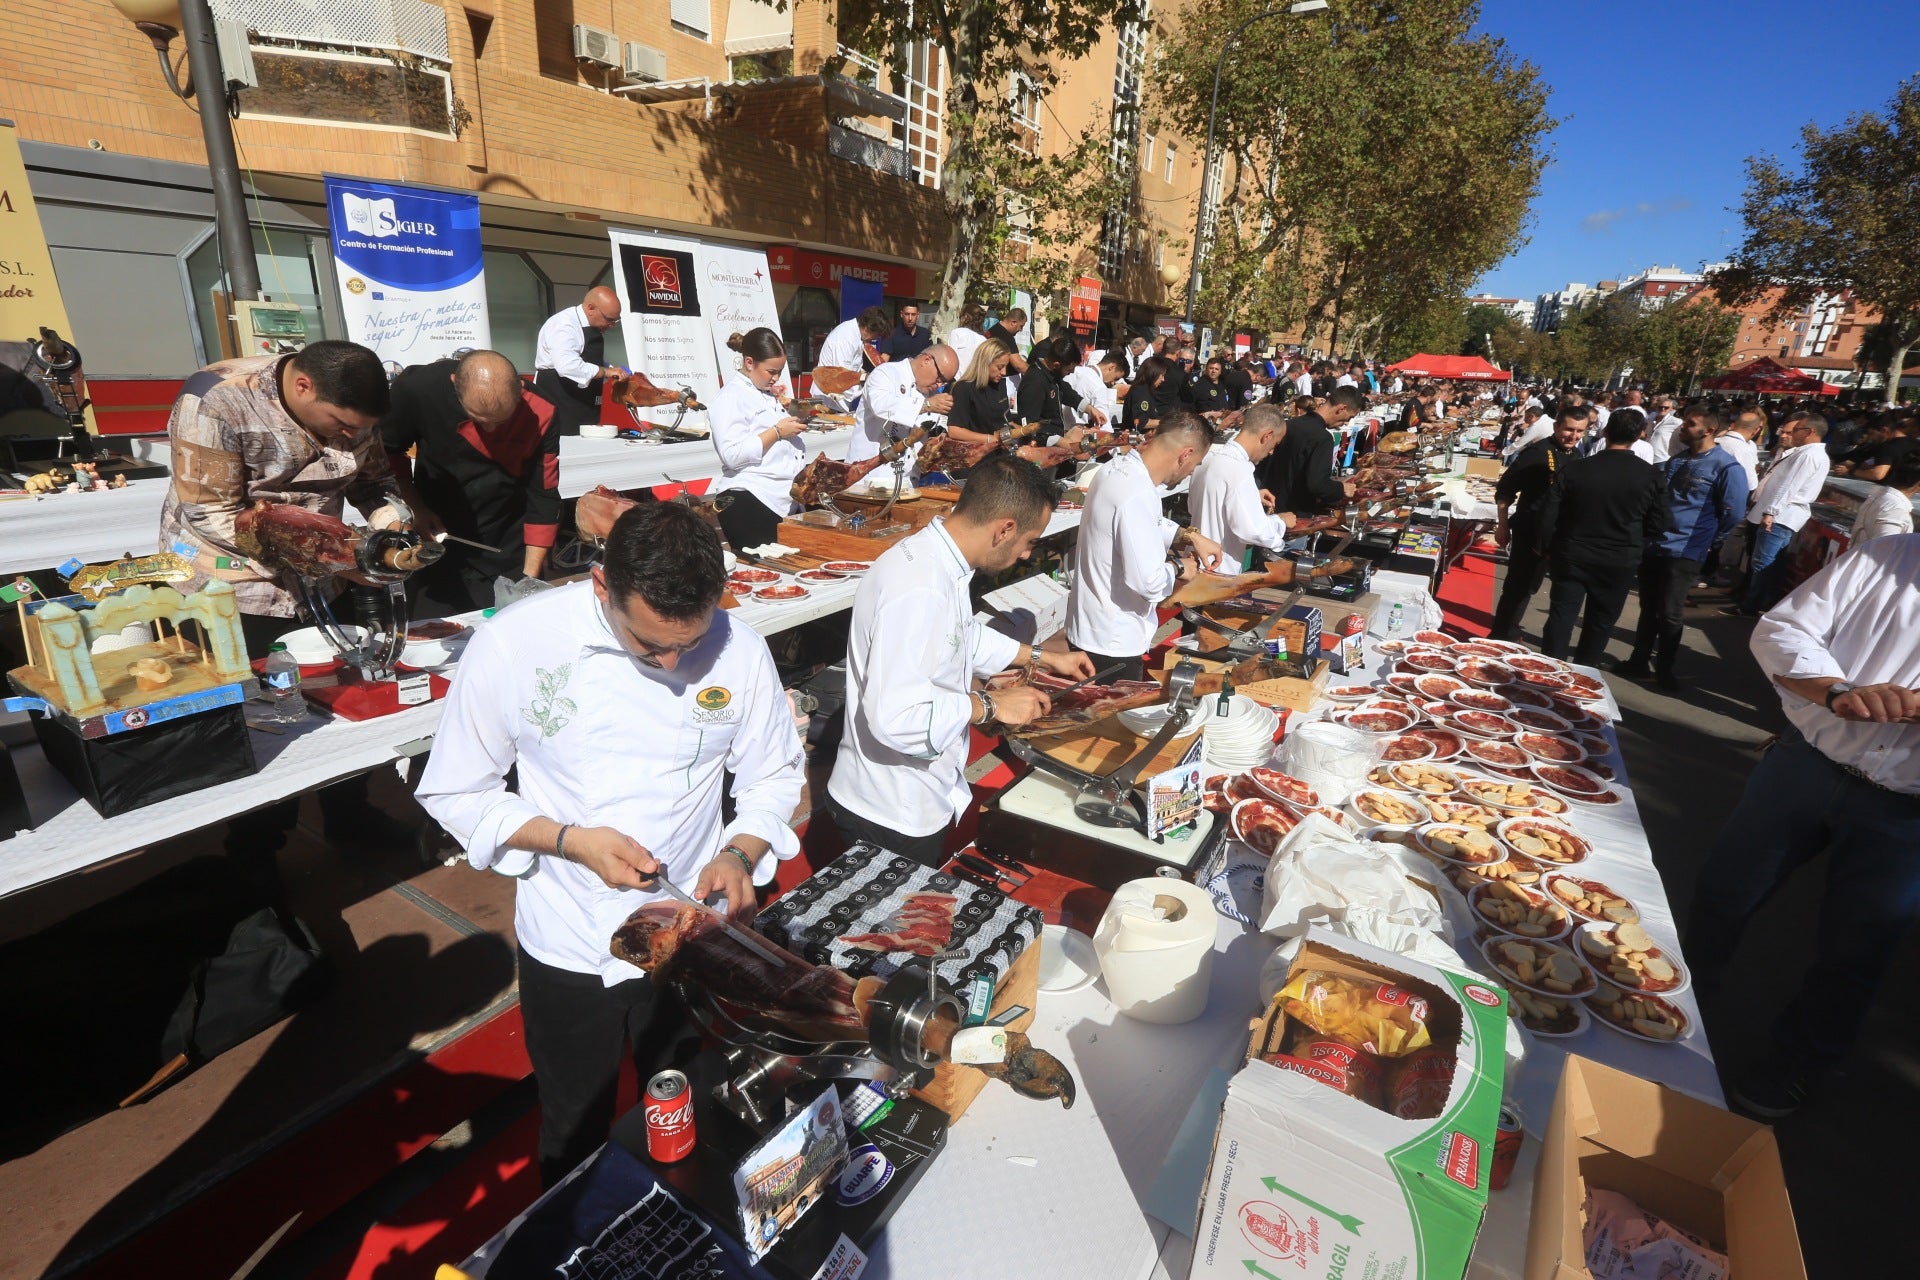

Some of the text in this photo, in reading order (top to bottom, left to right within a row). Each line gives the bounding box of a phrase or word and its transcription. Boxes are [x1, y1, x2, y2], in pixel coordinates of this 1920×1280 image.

[379, 211, 437, 236] SIGLER
[340, 239, 454, 257] Centro de Formación Profesional
[712, 273, 759, 287] MONTESIERRA
[649, 291, 680, 302] NAVIDUL
[365, 300, 481, 328] Nuestra meta es
[663, 318, 681, 326] Sigma
[364, 327, 406, 351] seguir
[1272, 1059, 1341, 1084] RANJOSE
[661, 1129, 681, 1137] SABOR
[1228, 1140, 1239, 1159] SECO
[1455, 1138, 1473, 1182] FRANJOSE
[844, 1154, 881, 1194] BUARFE
[1221, 1166, 1233, 1193] FRESCO
[1216, 1192, 1228, 1215] LUGAR
[1214, 1214, 1222, 1225] EN
[1206, 1224, 1220, 1266] CONSERVESE
